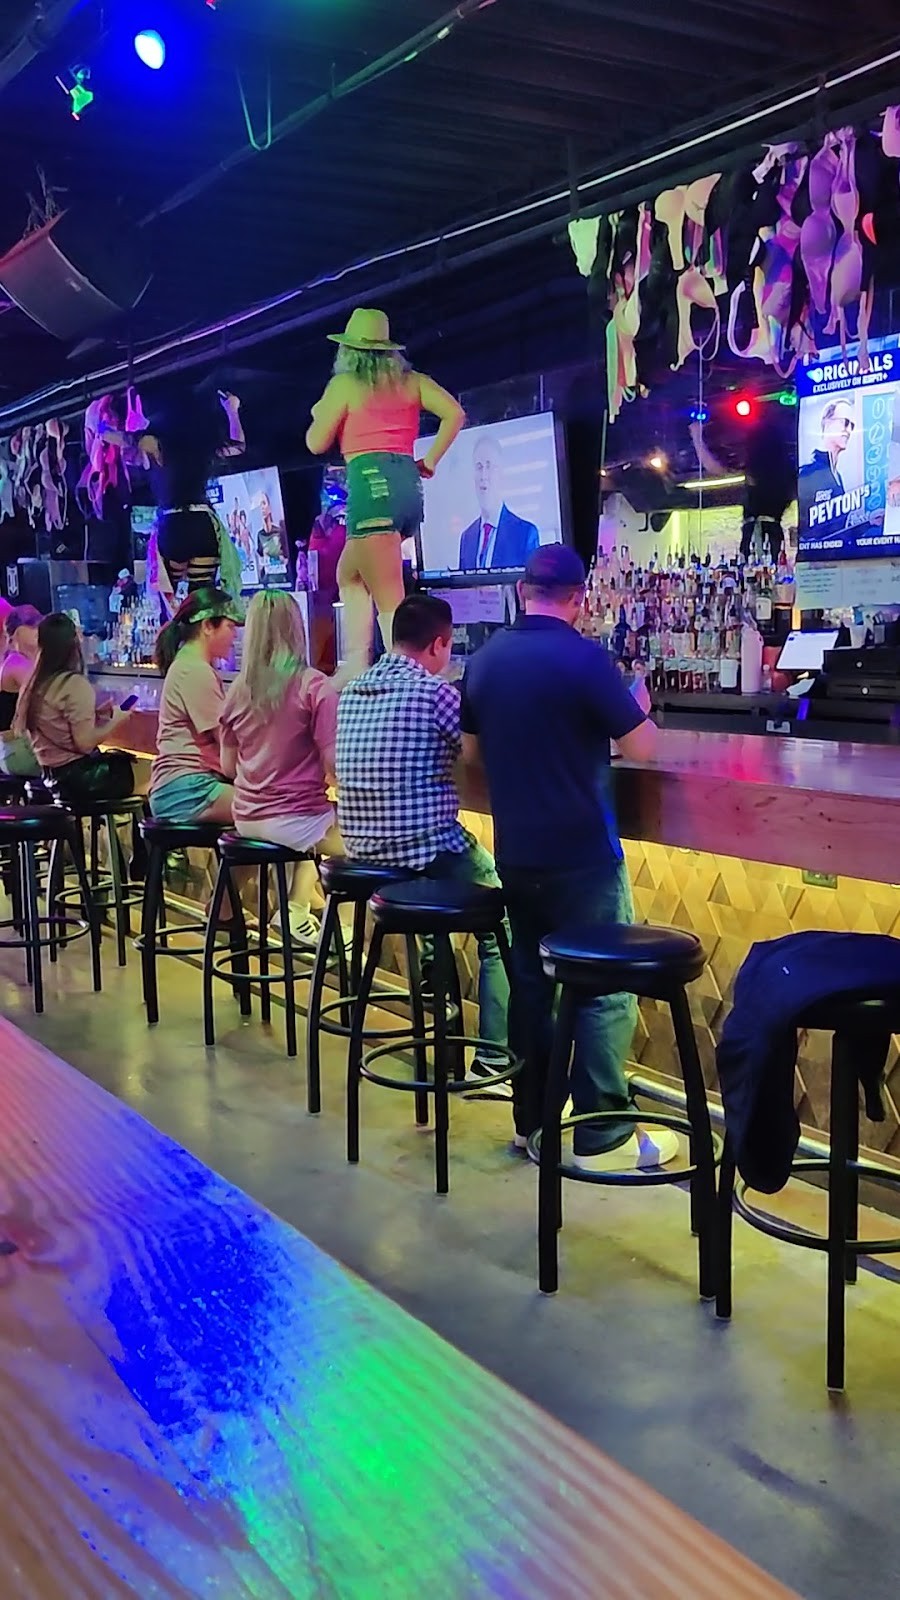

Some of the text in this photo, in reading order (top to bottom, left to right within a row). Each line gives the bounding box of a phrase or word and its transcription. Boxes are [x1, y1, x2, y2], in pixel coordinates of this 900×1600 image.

[813, 379, 851, 393] EXCLUSIVELY
[809, 484, 870, 528] PEYTON'S
[811, 541, 822, 549] HAS
[856, 538, 872, 546] YOUR
